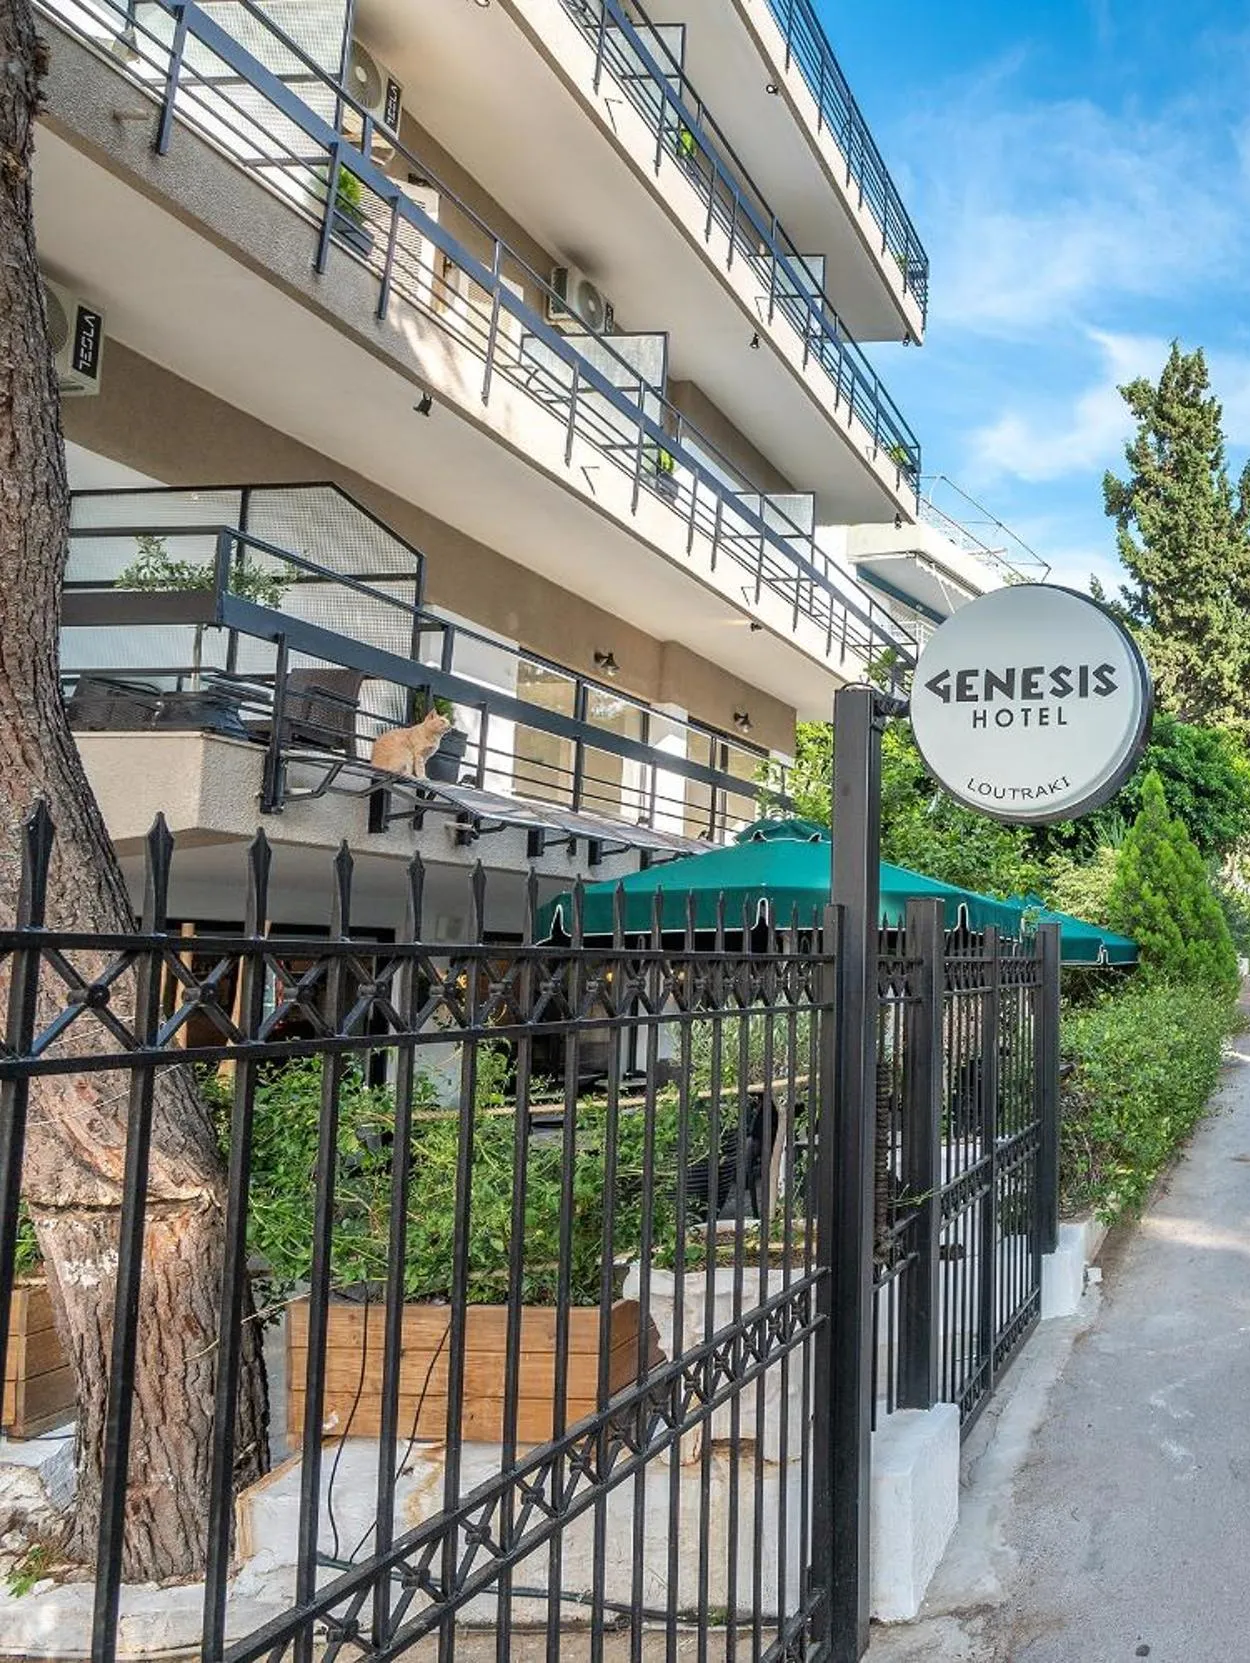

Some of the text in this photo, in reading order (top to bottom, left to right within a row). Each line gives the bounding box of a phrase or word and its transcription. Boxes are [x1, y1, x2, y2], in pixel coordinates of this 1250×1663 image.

[79, 315, 96, 370] TESLA
[924, 662, 1119, 704] GENESIS
[972, 706, 1067, 729] HOTEL
[967, 775, 1071, 801] LOUTRAKI
